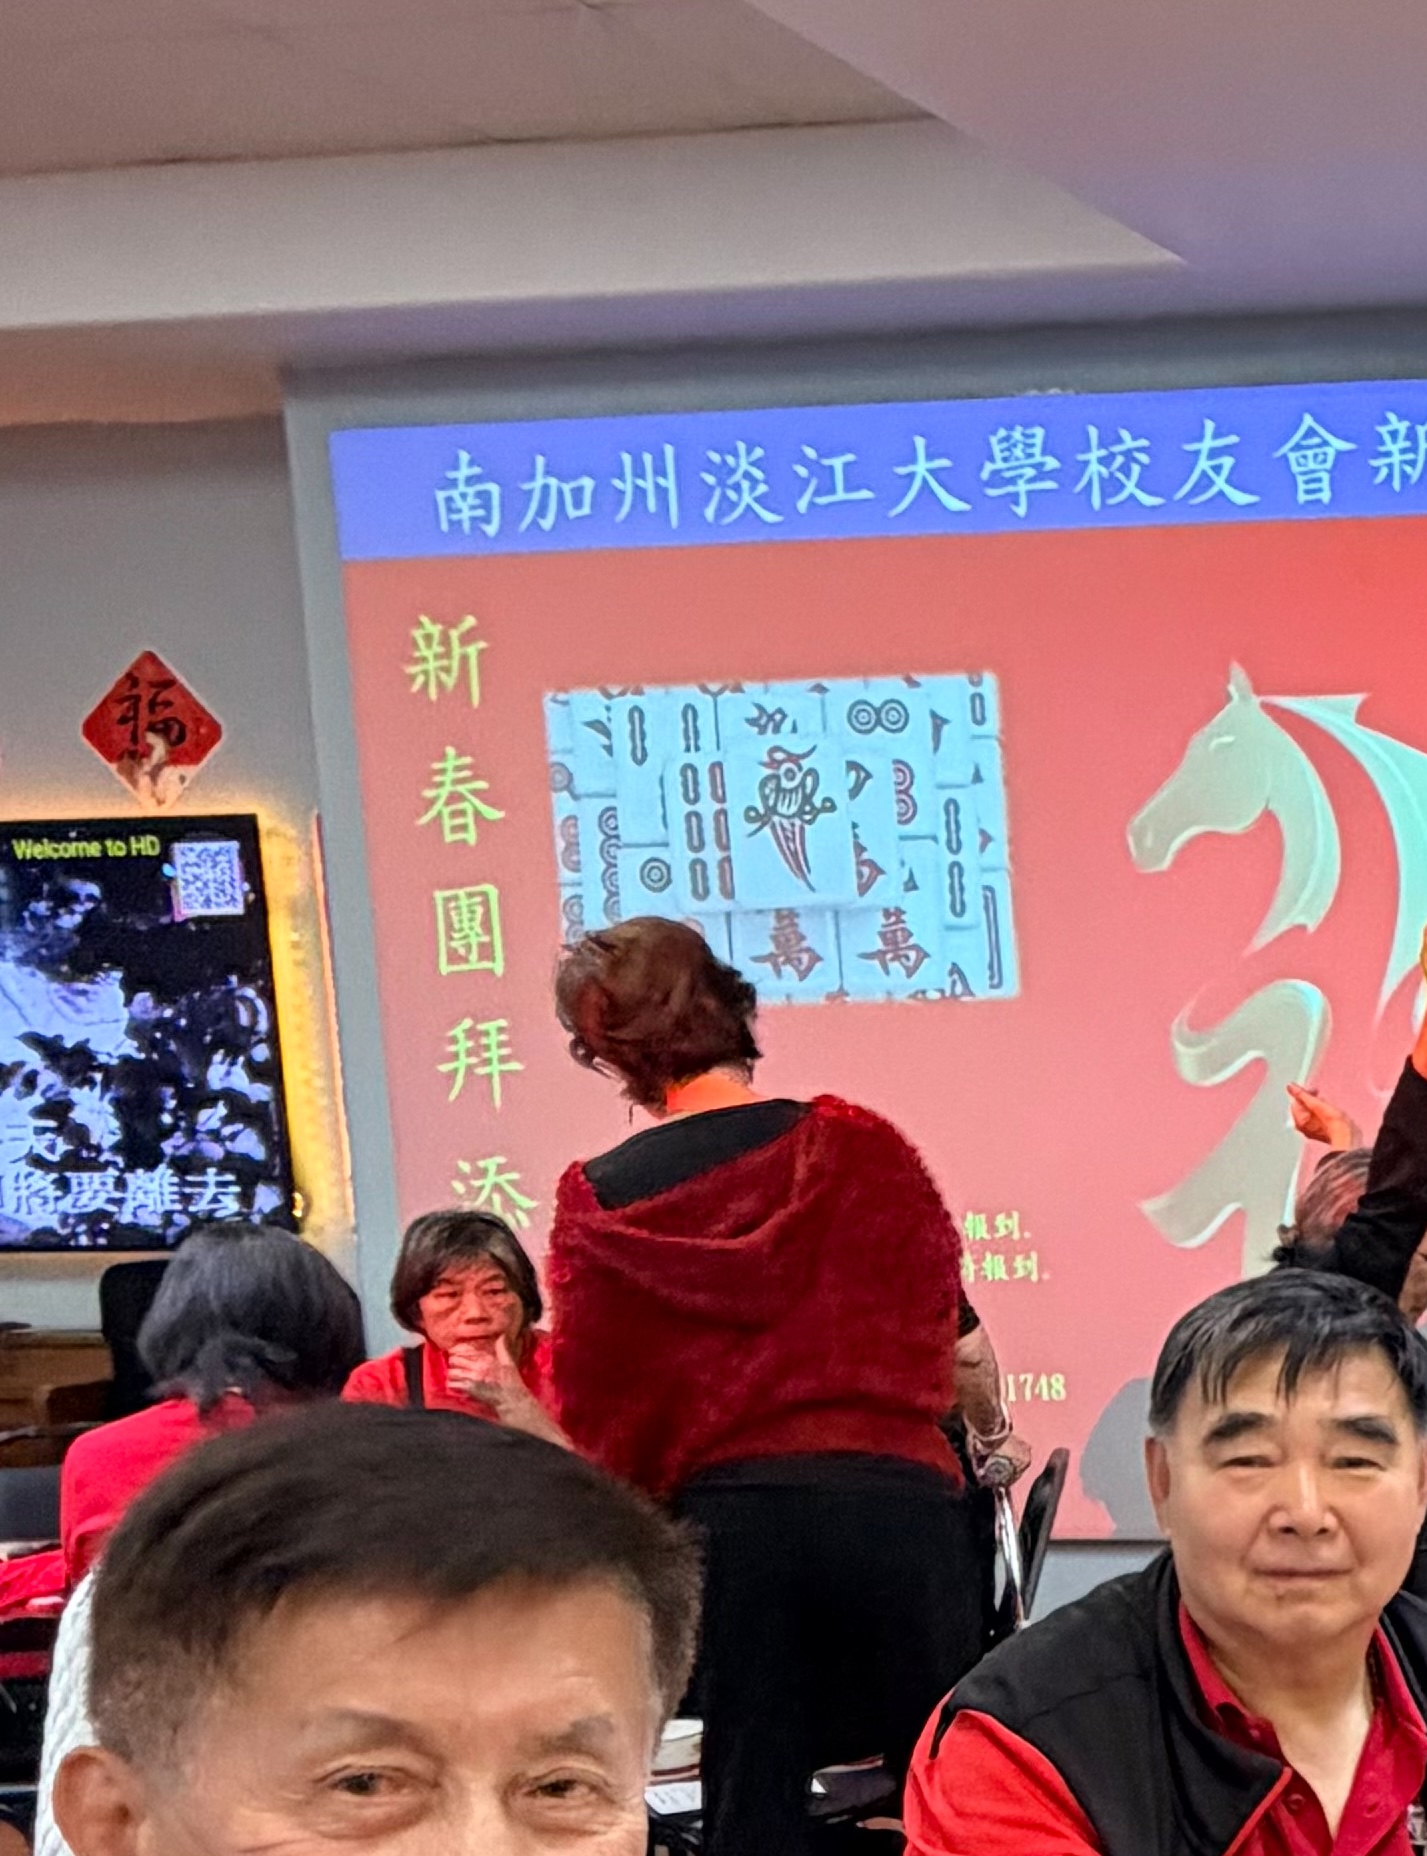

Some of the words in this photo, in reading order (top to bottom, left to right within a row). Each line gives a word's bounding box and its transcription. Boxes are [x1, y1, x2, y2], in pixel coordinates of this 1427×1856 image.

[12, 839, 101, 860] Welcome
[105, 838, 127, 858] to
[130, 834, 161, 857] HD
